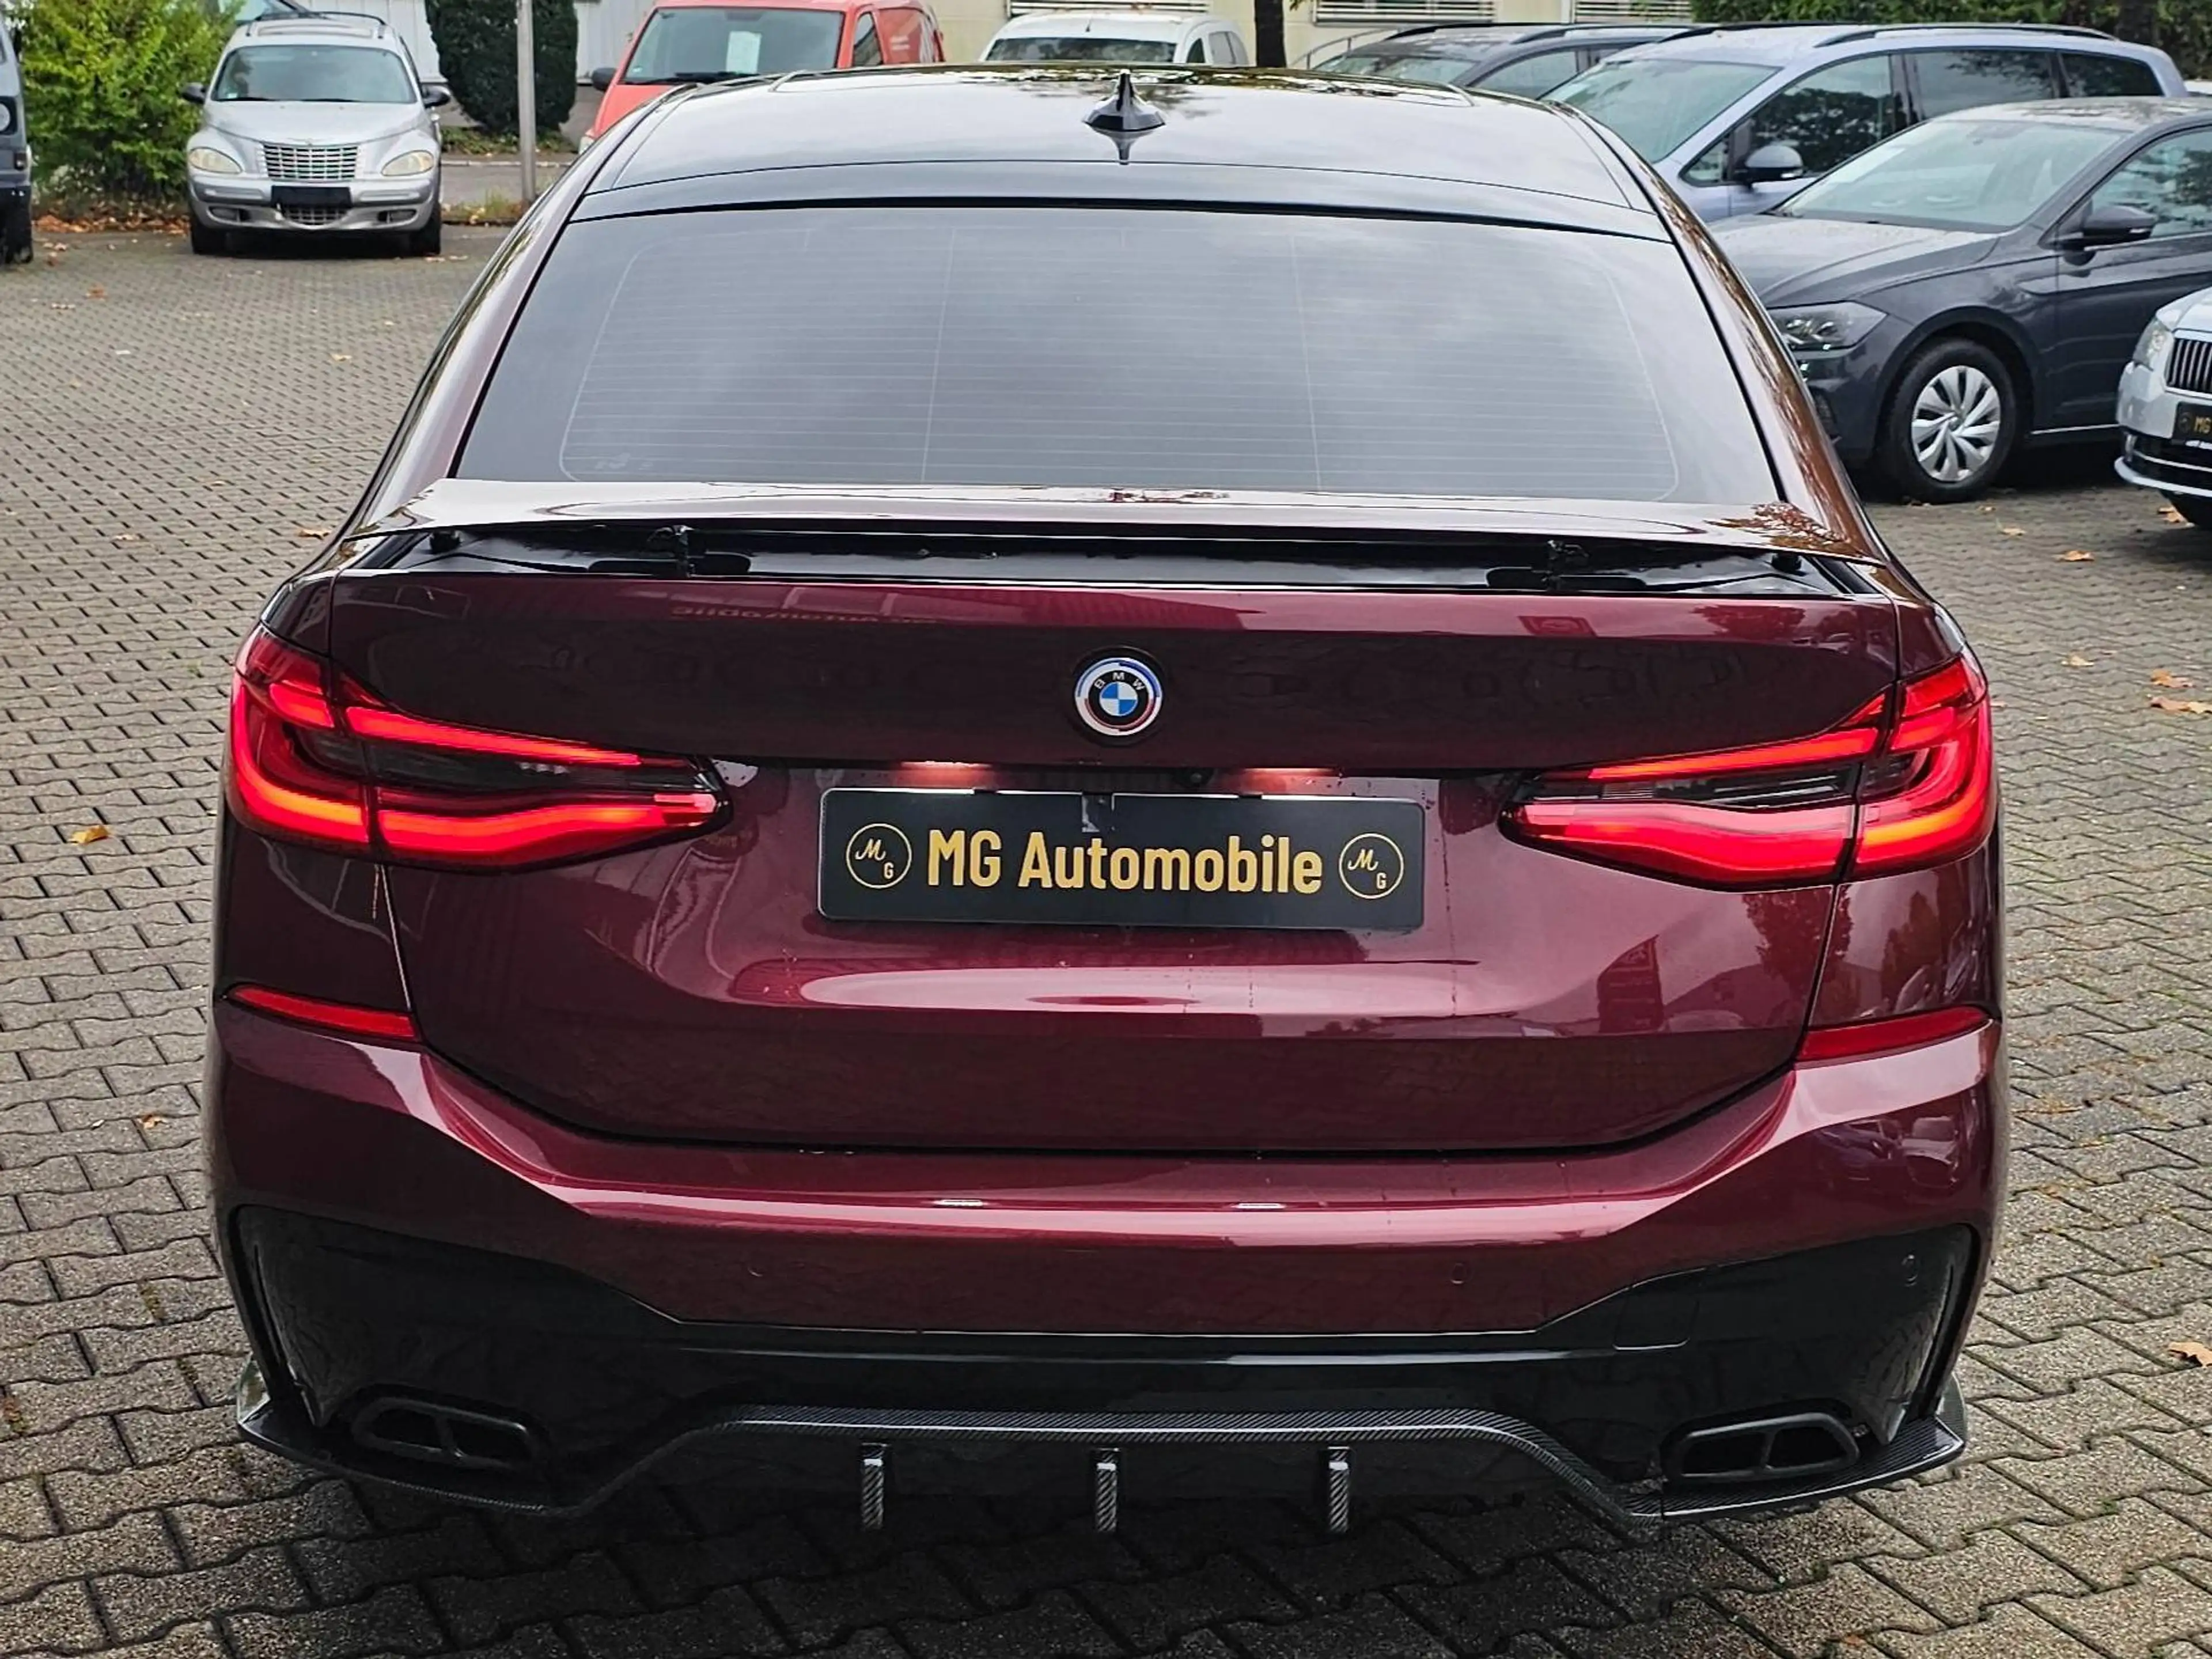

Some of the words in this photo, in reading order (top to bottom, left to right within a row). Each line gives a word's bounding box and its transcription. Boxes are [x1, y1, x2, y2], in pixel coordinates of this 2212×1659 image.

[1094, 672, 1145, 691] BMW
[927, 829, 1002, 887] MG
[1017, 831, 1323, 894] Automobile
